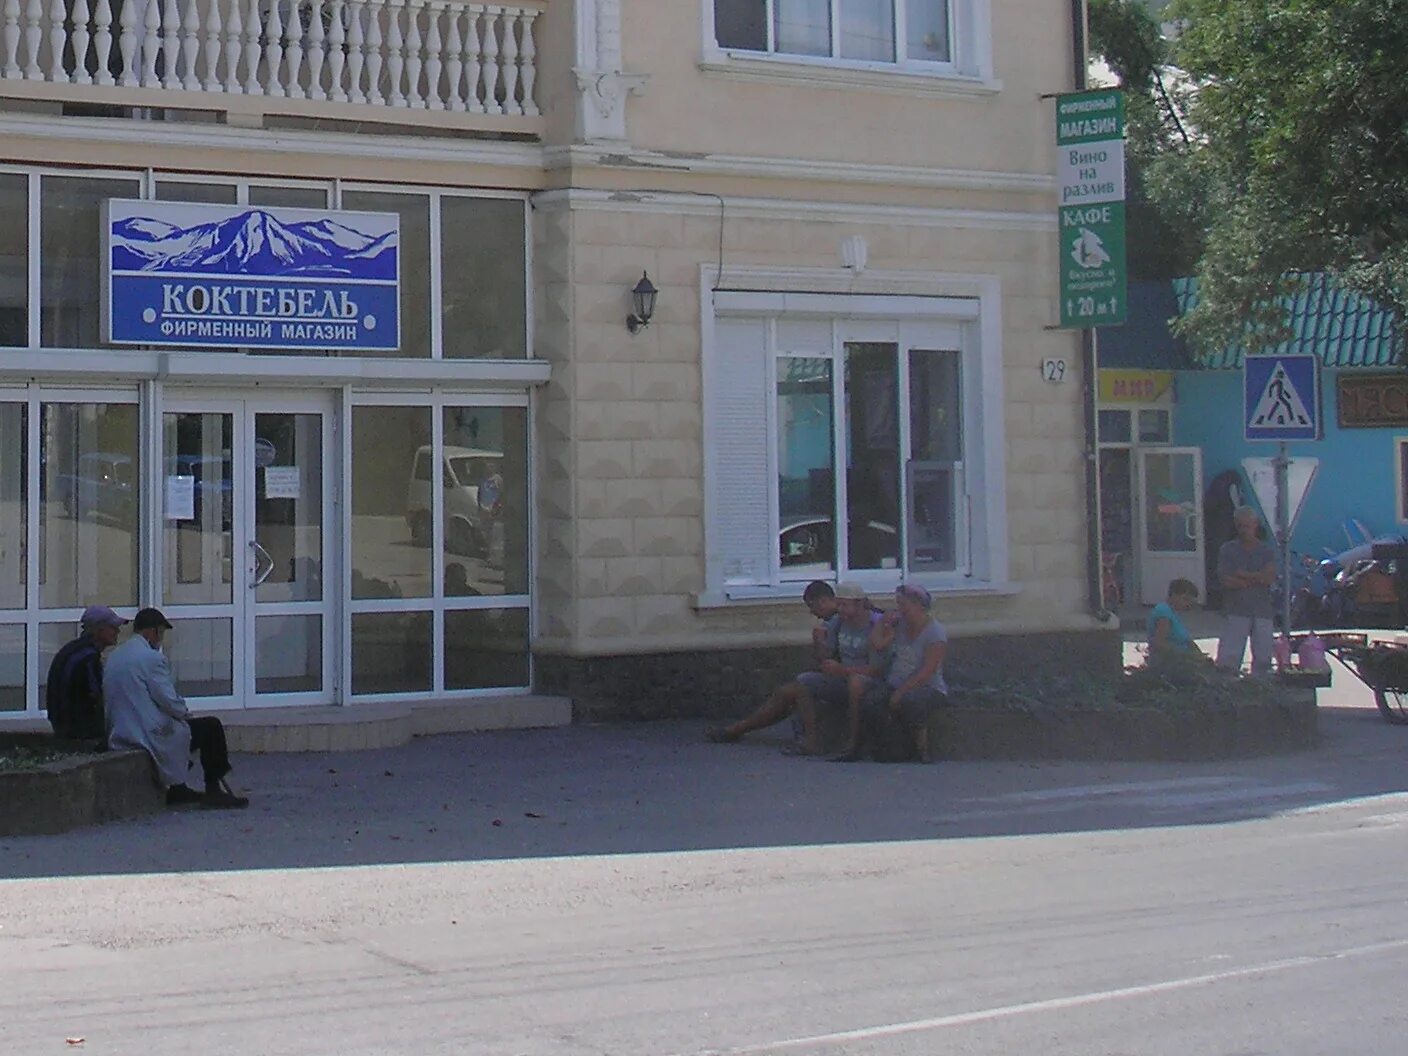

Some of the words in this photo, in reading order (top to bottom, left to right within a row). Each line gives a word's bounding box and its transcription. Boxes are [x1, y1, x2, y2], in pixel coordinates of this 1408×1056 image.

[1060, 116, 1117, 138] МАГАЗИН
[1069, 150, 1108, 166] Вино
[1079, 167, 1097, 180] на
[1063, 181, 1115, 203] разлив
[1063, 206, 1112, 227] КАФЕ
[162, 284, 358, 319] КОКТЕБЕЛЬ
[1077, 296, 1094, 316] 20
[160, 319, 272, 339] ФИРМЕННЫЙ
[281, 324, 357, 340] МАГАЗИН
[1046, 359, 1066, 381] 29
